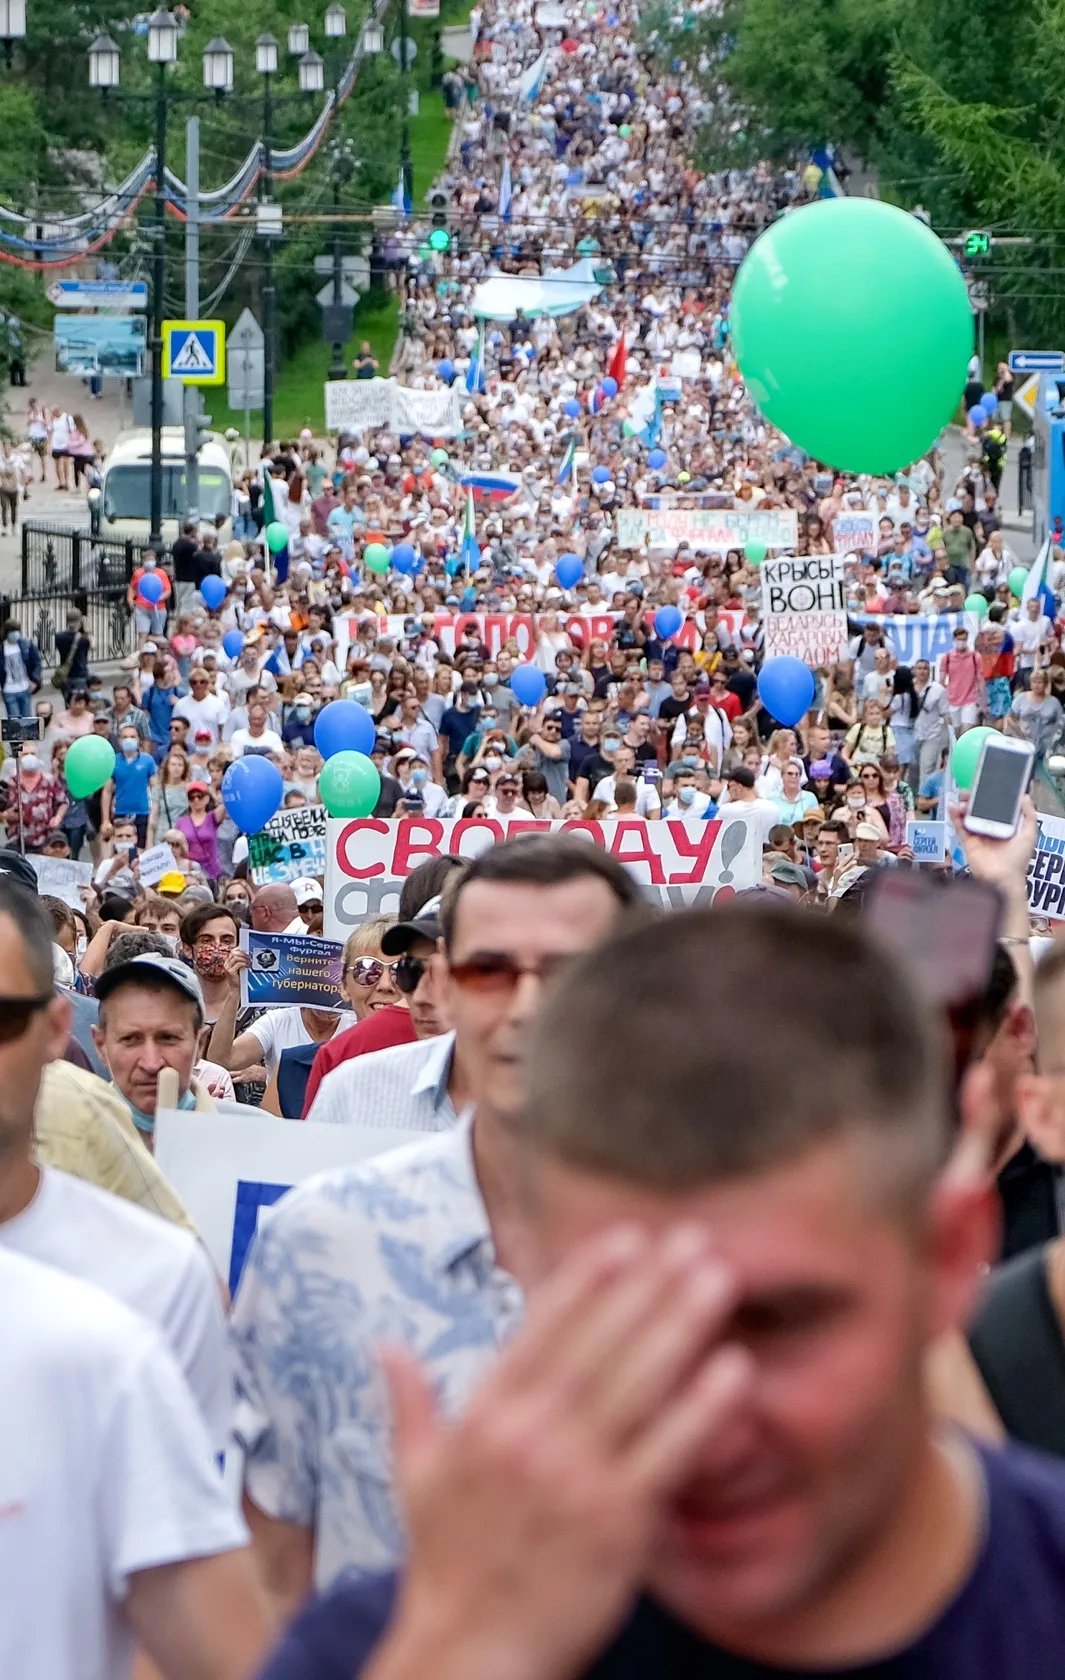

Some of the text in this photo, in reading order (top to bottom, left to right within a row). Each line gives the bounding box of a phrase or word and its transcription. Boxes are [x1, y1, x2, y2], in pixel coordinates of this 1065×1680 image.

[271, 936, 342, 951] Я-МЫ-Серге
[286, 954, 334, 966] Верните
[288, 967, 331, 978] нашего
[272, 977, 343, 994] губернатора
